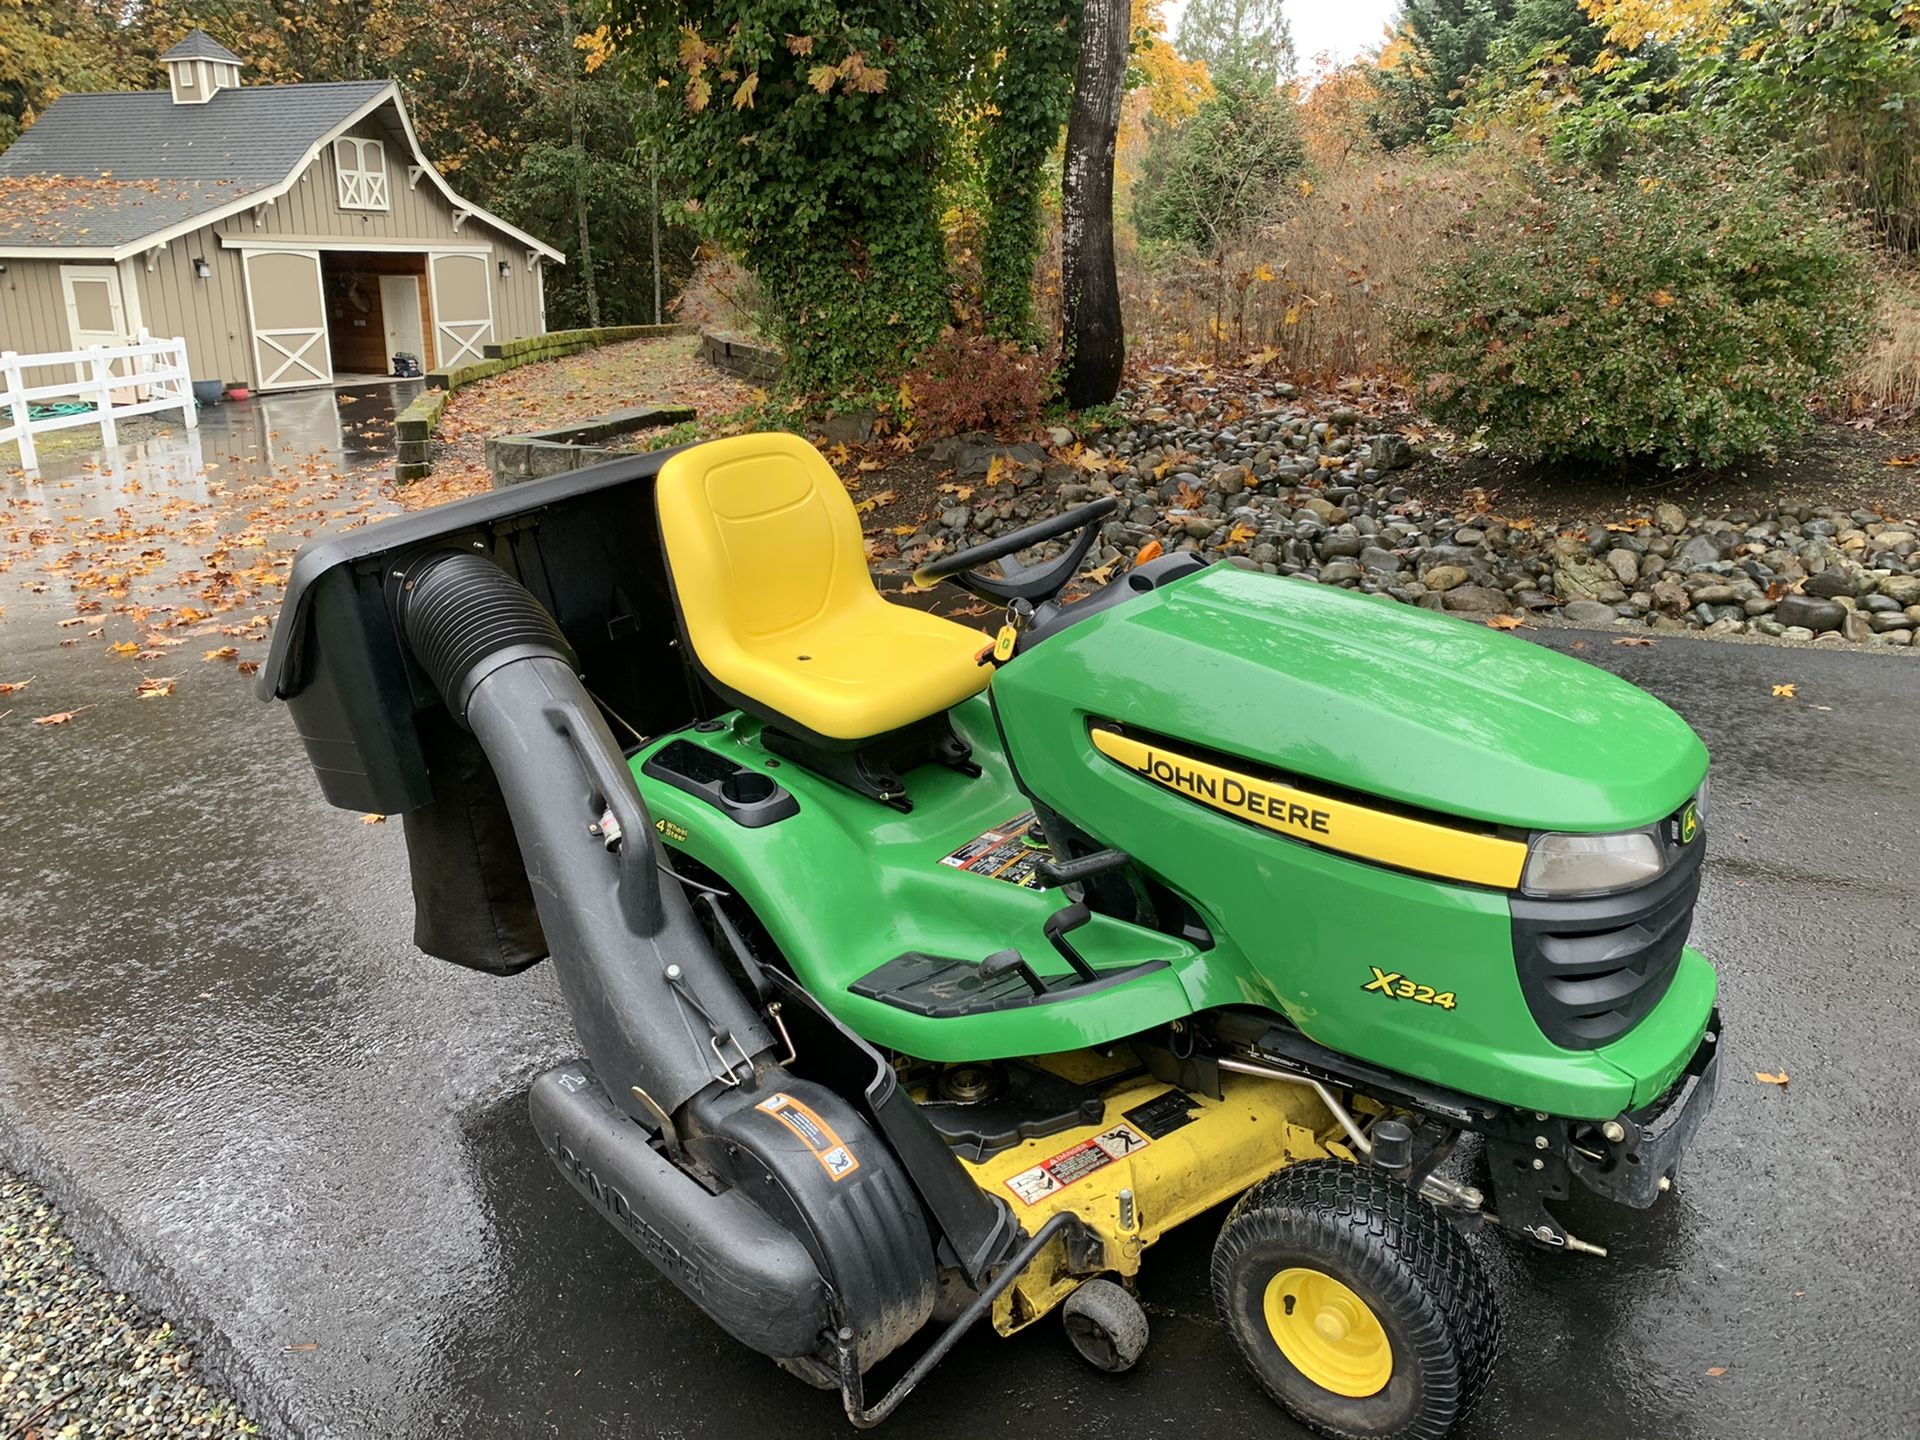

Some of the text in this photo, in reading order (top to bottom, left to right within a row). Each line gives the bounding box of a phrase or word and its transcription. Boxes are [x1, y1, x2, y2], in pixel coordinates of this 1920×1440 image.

[1138, 752, 1331, 834] JOHN DEERE
[655, 818, 688, 836] 4 Wheel
[665, 828, 686, 843] Steer
[1361, 965, 1457, 1011] X324
[549, 1131, 706, 1297] JOHN DEERE
